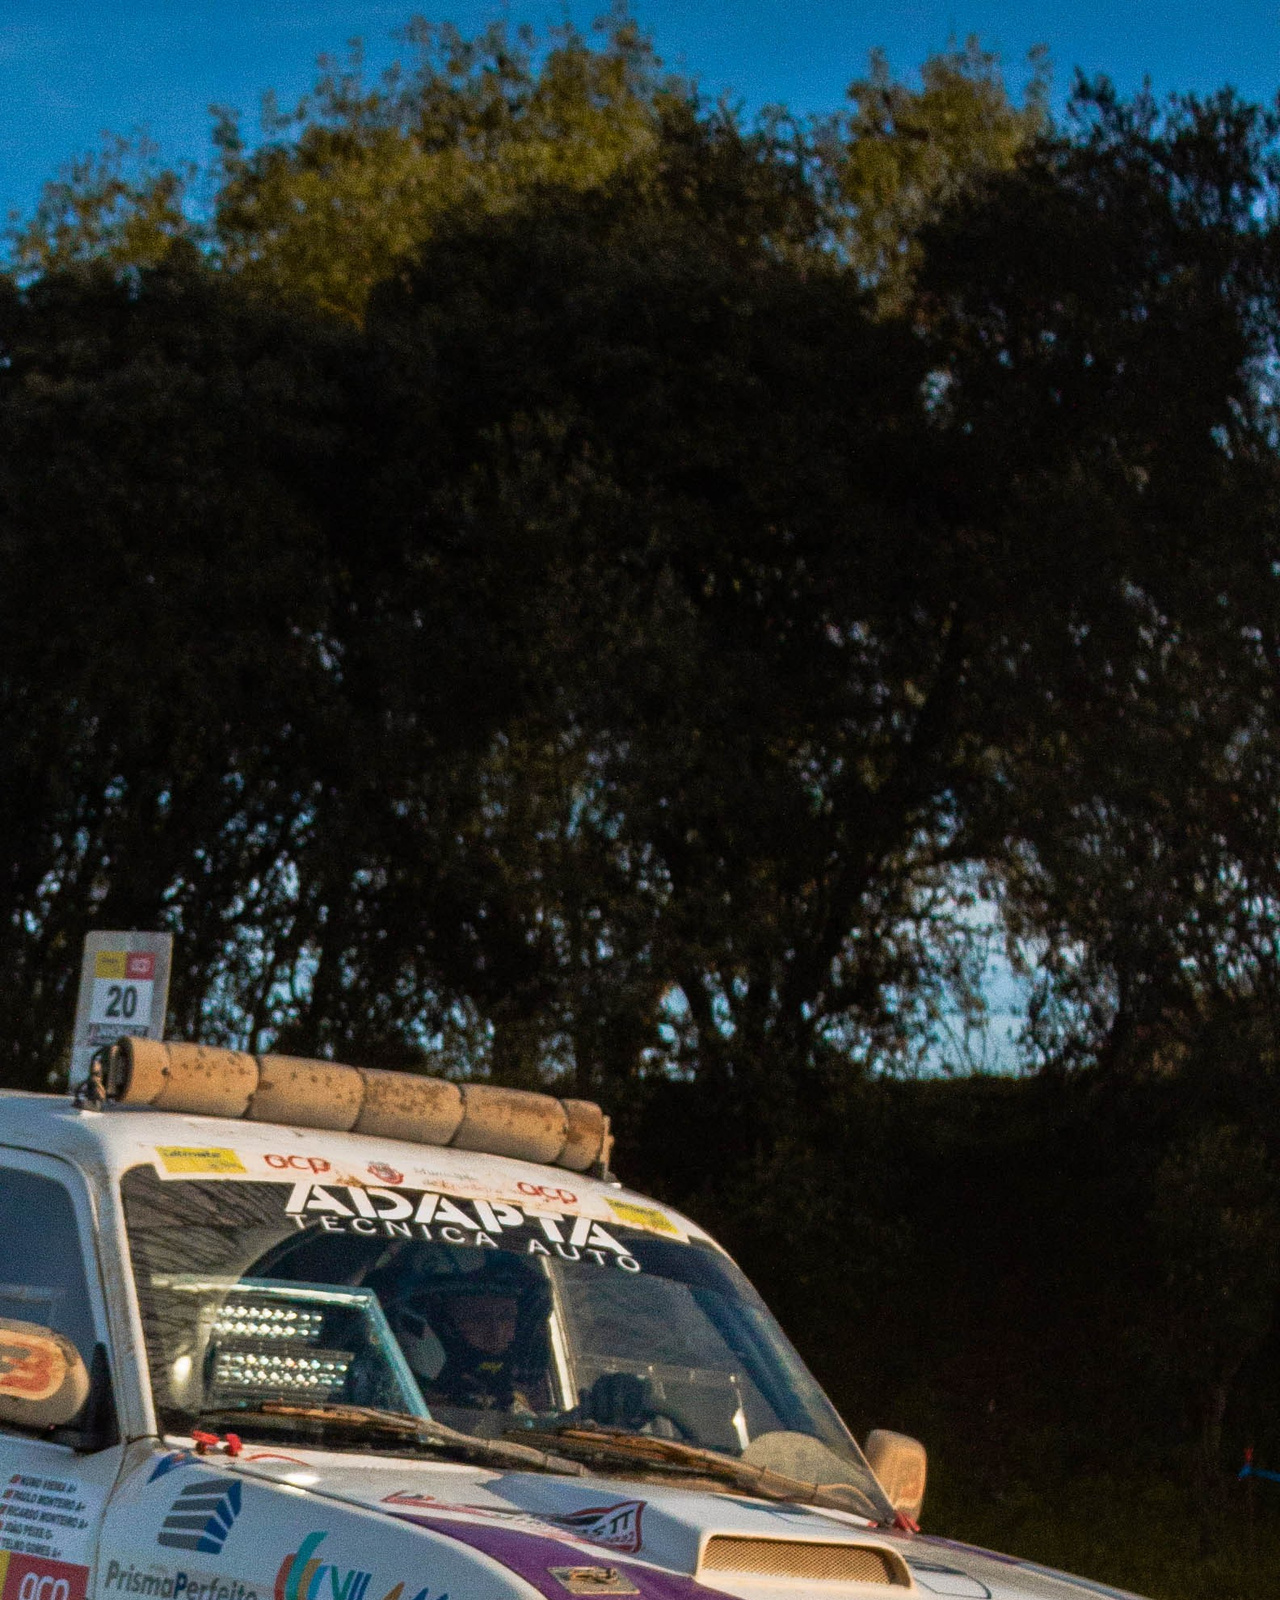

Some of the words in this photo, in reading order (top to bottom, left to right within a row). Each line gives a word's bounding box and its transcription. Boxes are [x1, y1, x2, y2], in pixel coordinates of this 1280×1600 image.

[105, 985, 138, 1018] 20
[286, 1182, 633, 1257] ADAPTA
[286, 1214, 499, 1249] TECNICA
[528, 1238, 642, 1273] AUTO
